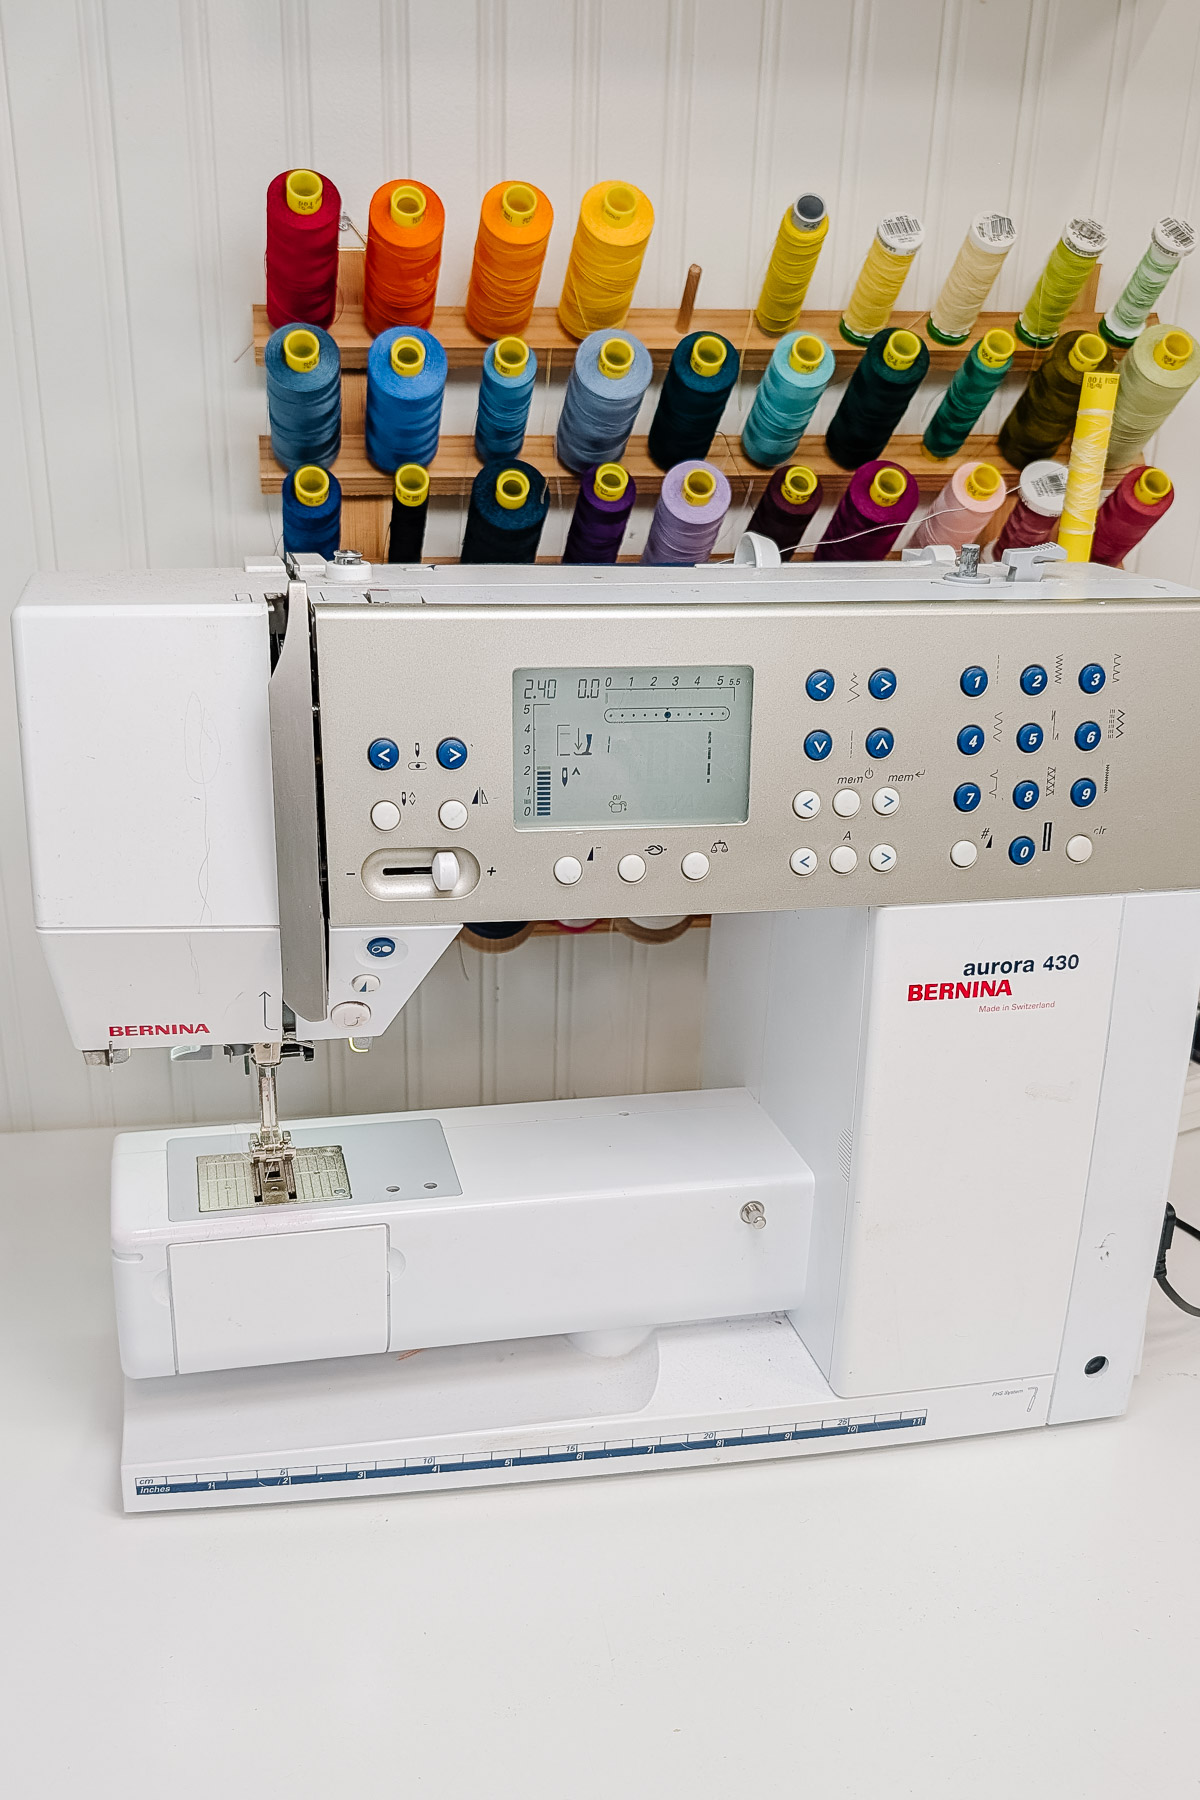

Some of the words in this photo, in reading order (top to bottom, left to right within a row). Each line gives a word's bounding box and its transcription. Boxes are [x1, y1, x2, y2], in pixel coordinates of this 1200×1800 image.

[605, 676, 612, 688] 0
[629, 676, 634, 687] 1
[650, 676, 658, 687] 2
[671, 676, 680, 687] 3
[694, 676, 701, 687] 4
[716, 675, 725, 686] 5
[728, 677, 741, 687] 5.5
[974, 675, 982, 689] 1
[1031, 674, 1043, 688] 2
[1091, 673, 1101, 686] 3
[523, 679, 557, 700] 2.40
[577, 678, 600, 699] 0.0
[523, 704, 531, 715] 5
[524, 723, 531, 734] 4
[968, 735, 978, 748] 4
[1028, 733, 1039, 746] 5
[1086, 731, 1096, 744] 6
[523, 744, 531, 755] 3
[523, 765, 531, 776] 2
[837, 776, 864, 785] mem
[887, 774, 914, 783] mem
[525, 786, 531, 796] 1
[1024, 790, 1034, 803] 8
[1081, 788, 1091, 801] 9
[965, 792, 976, 805] 7
[523, 806, 531, 817] 0
[842, 830, 852, 841] A
[1019, 846, 1029, 858] 0
[963, 959, 1035, 977] aurora
[1042, 954, 1080, 971] 430
[907, 979, 1013, 1002] BERNINA
[978, 1005, 1001, 1013] Made
[1002, 1004, 1010, 1012] in
[1011, 1001, 1056, 1011] Switzerland
[109, 1023, 210, 1037] BERNINA
[423, 1457, 433, 1465] 10
[703, 1432, 714, 1440] 20
[140, 1485, 171, 1494] inches
[431, 1465, 437, 1473] 4
[575, 1452, 582, 1460] 6
